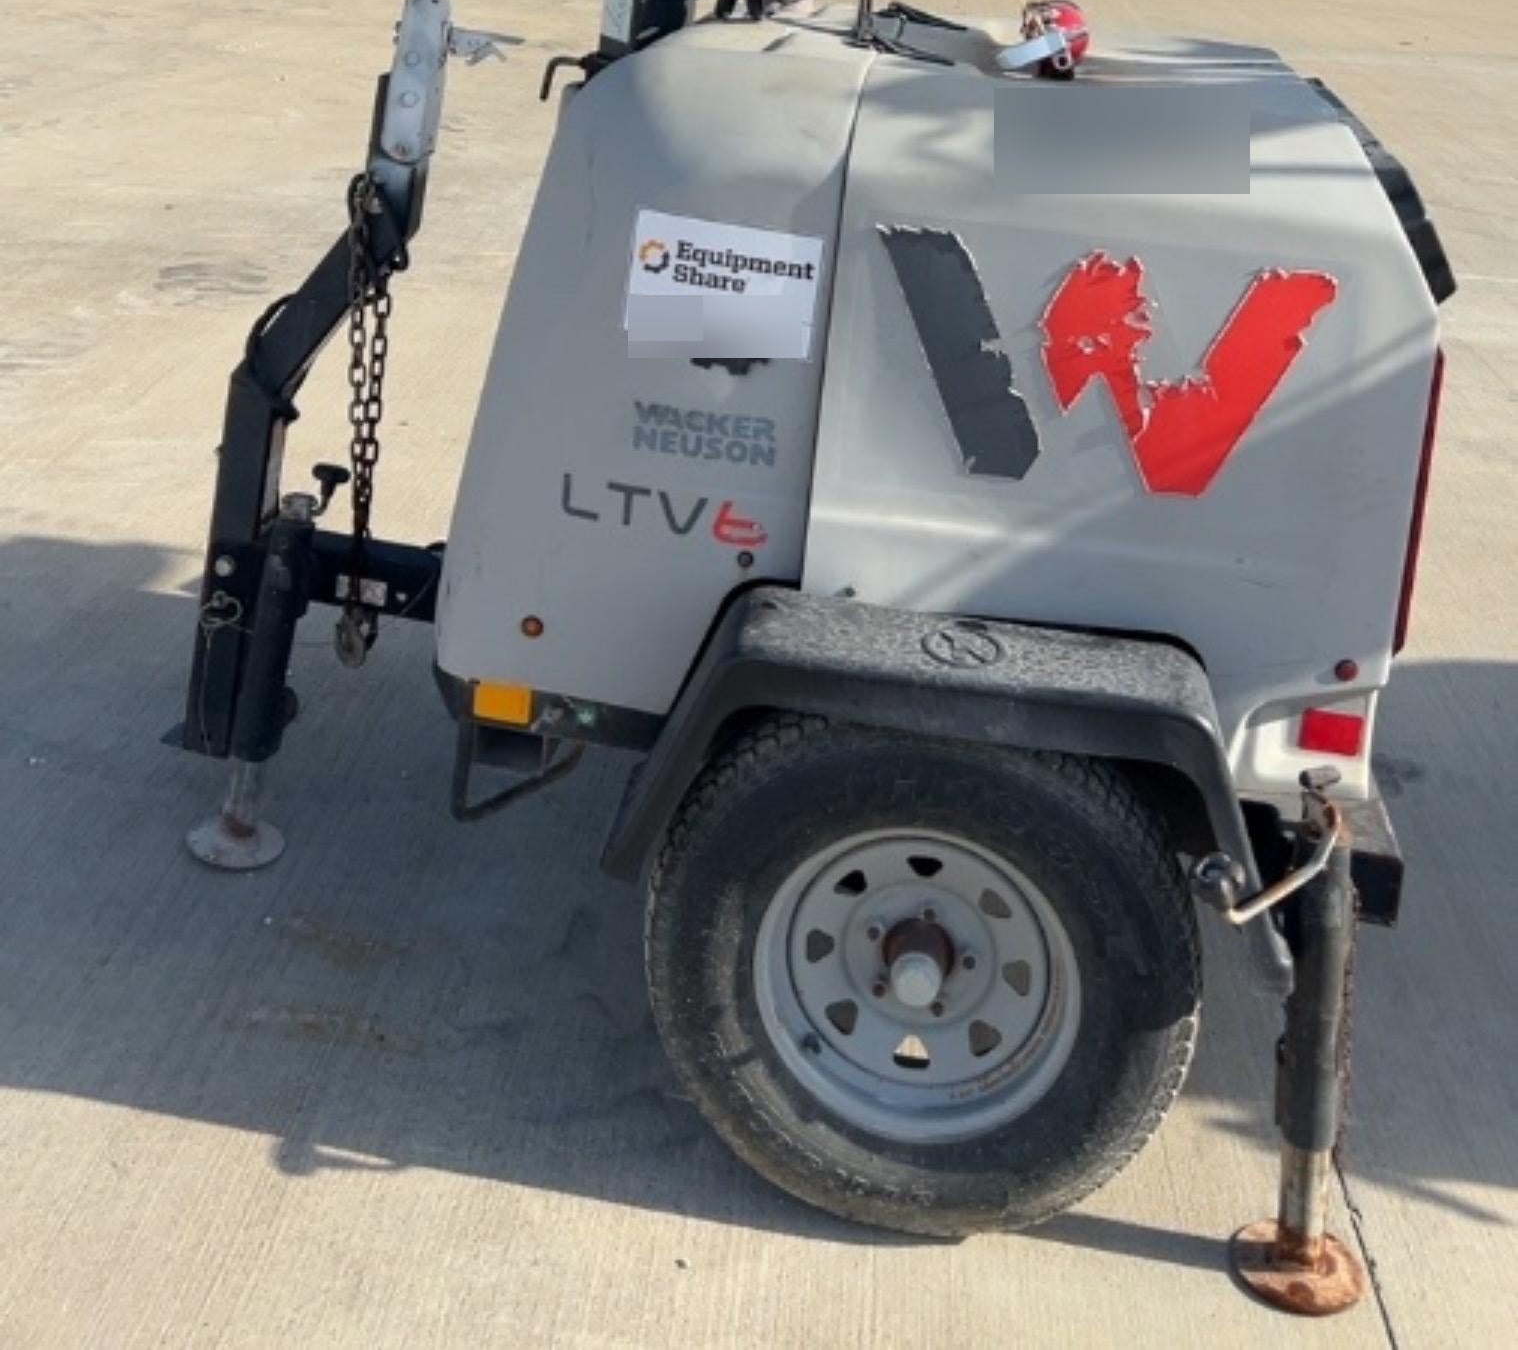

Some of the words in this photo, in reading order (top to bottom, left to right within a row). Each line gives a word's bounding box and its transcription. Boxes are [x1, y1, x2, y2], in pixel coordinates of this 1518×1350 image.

[672, 263, 747, 294] Share
[675, 239, 816, 281] Equipment
[634, 401, 776, 443] WACKER
[632, 425, 776, 467] NEUSON
[561, 472, 770, 546] LTV6
